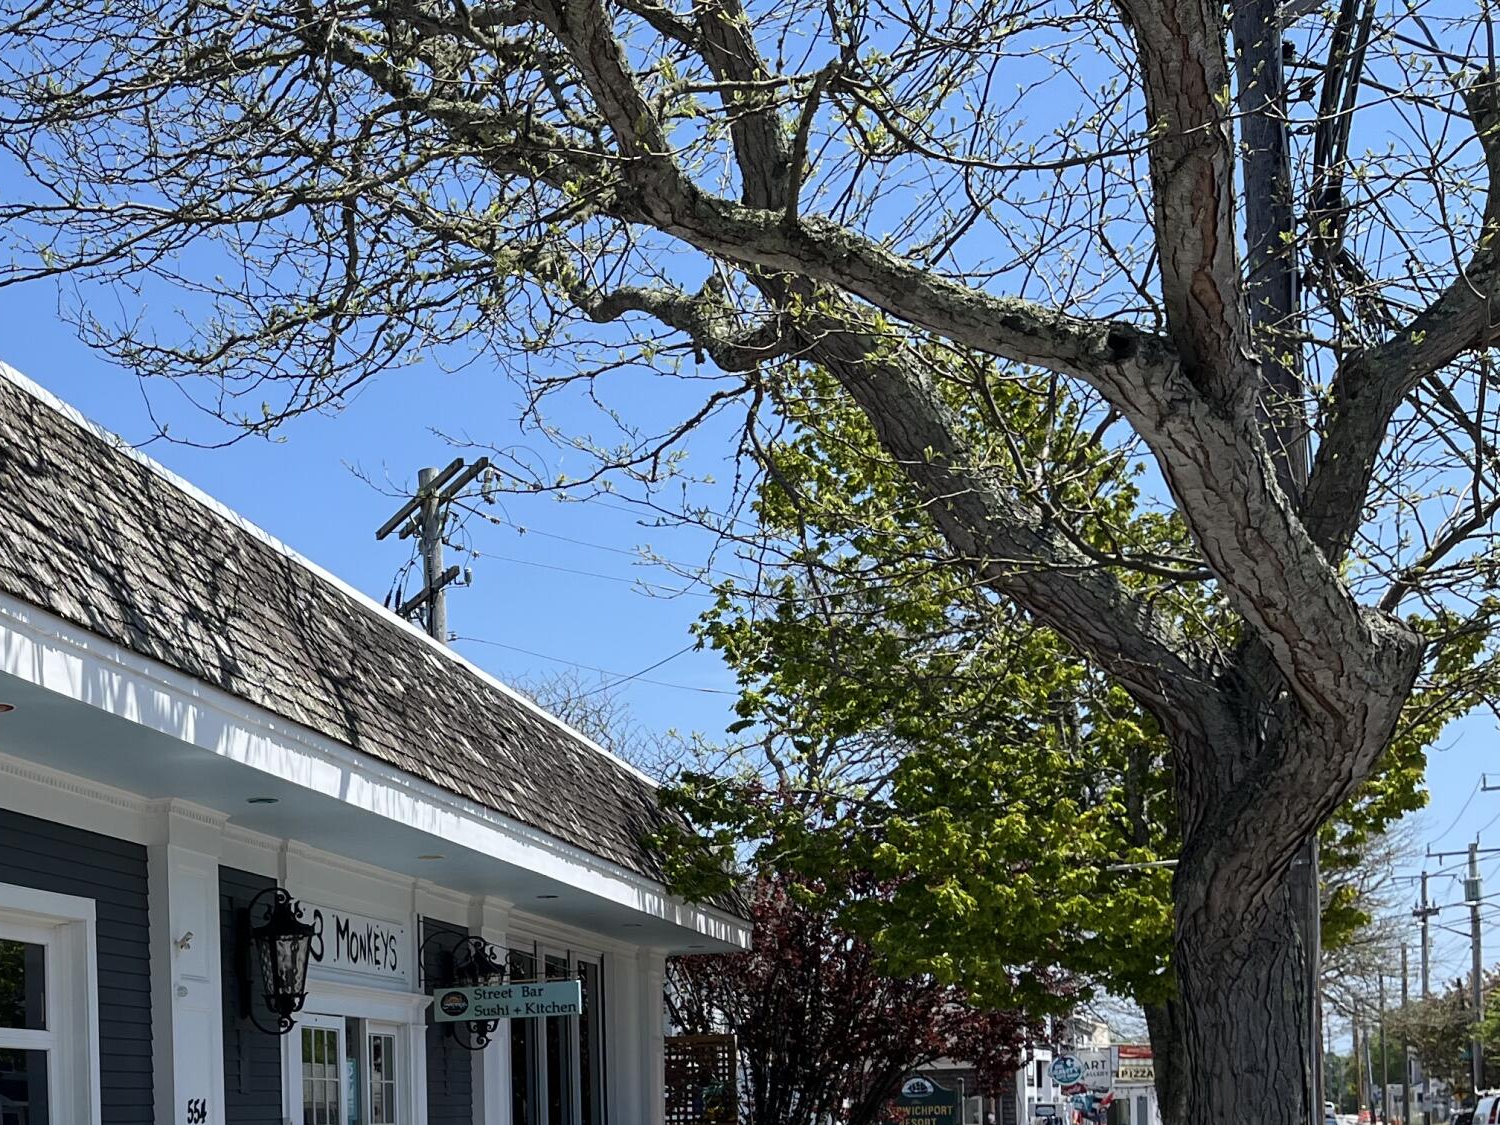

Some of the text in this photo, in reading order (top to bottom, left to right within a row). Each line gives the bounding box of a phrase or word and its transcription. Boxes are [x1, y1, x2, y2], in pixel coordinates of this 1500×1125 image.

[310, 909, 398, 972] 3 MONKEYS
[474, 986, 544, 1000] Street Bar
[474, 1005, 509, 1017] Sushi
[525, 1001, 576, 1015] Kitchen
[1083, 1060, 1106, 1070] ART
[1121, 1070, 1154, 1078] PIZZA
[187, 1098, 207, 1124] 554
